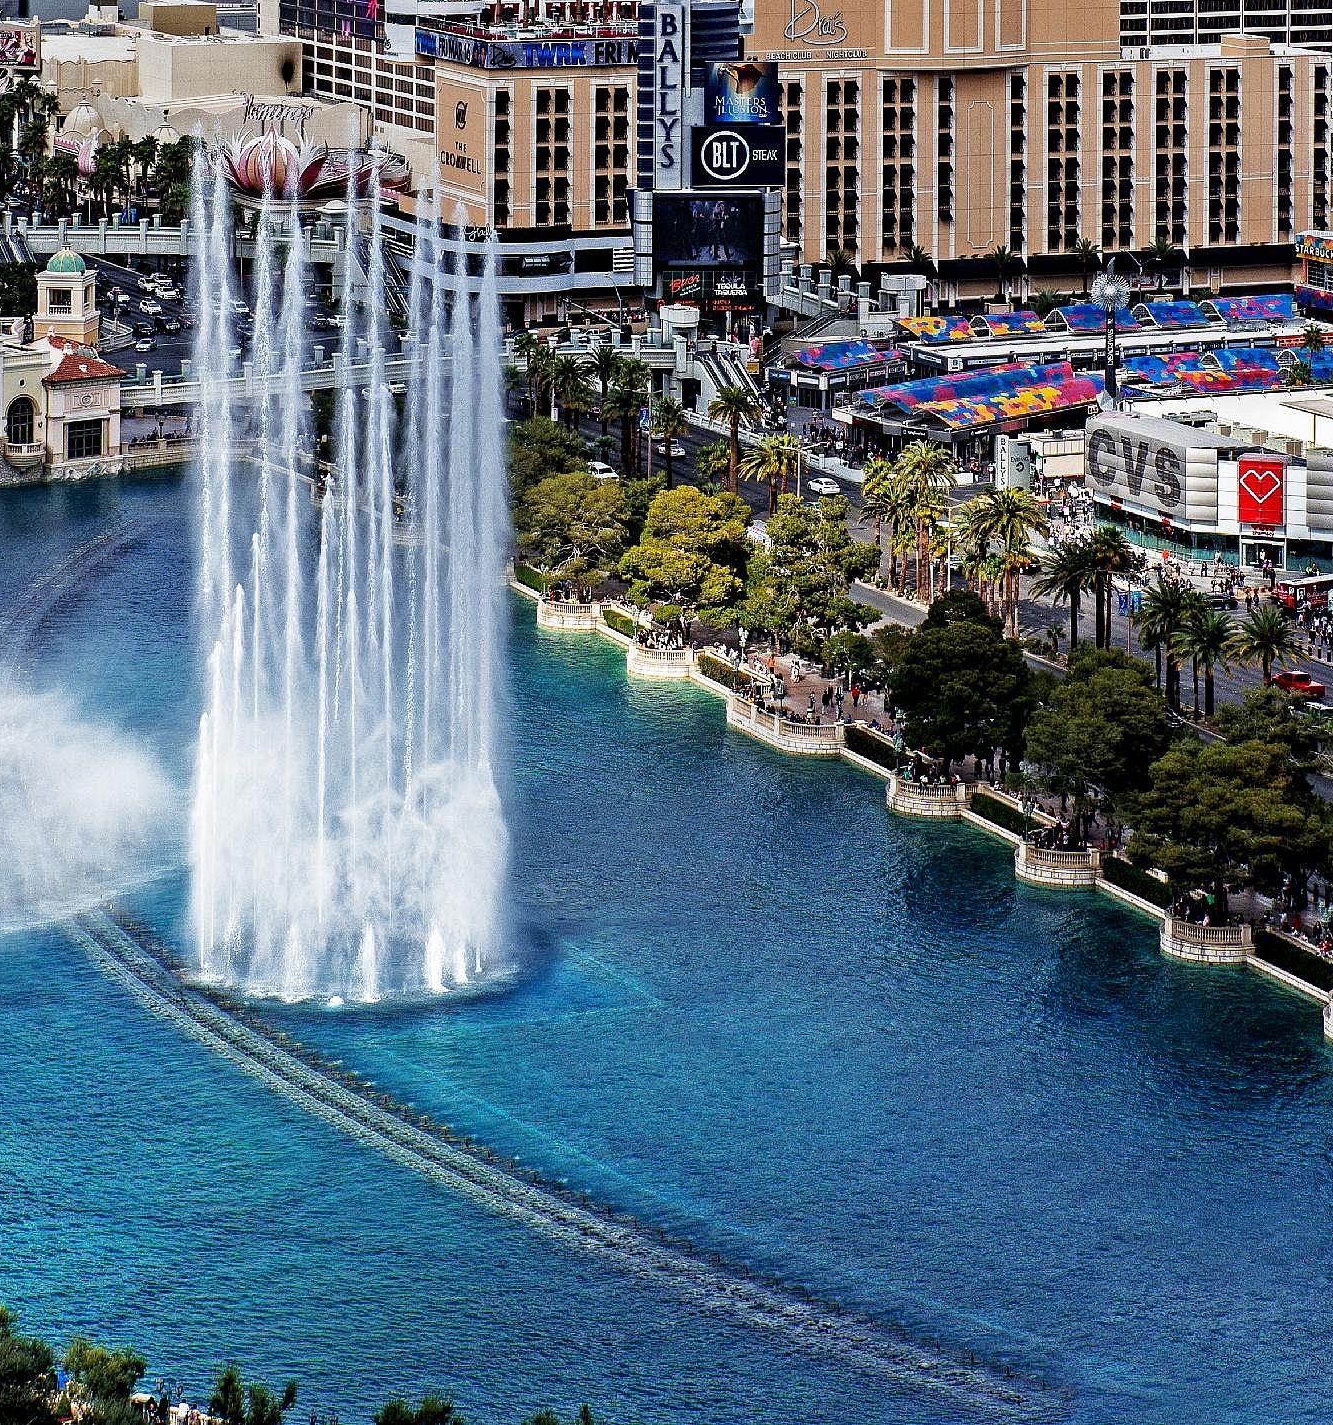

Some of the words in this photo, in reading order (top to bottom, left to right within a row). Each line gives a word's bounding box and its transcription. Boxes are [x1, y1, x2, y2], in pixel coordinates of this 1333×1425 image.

[522, 43, 586, 66] TWRK
[595, 42, 618, 65] FRI
[765, 52, 791, 60] BEACH
[793, 51, 812, 60] CLUB
[827, 50, 867, 58] NIGHTCLUB
[715, 95, 766, 106] MASTERS
[455, 141, 467, 153] THE
[712, 141, 739, 168] BLT
[752, 149, 778, 161] STEAK
[440, 151, 482, 175] CROMWELL
[1088, 428, 1181, 508] CVS
